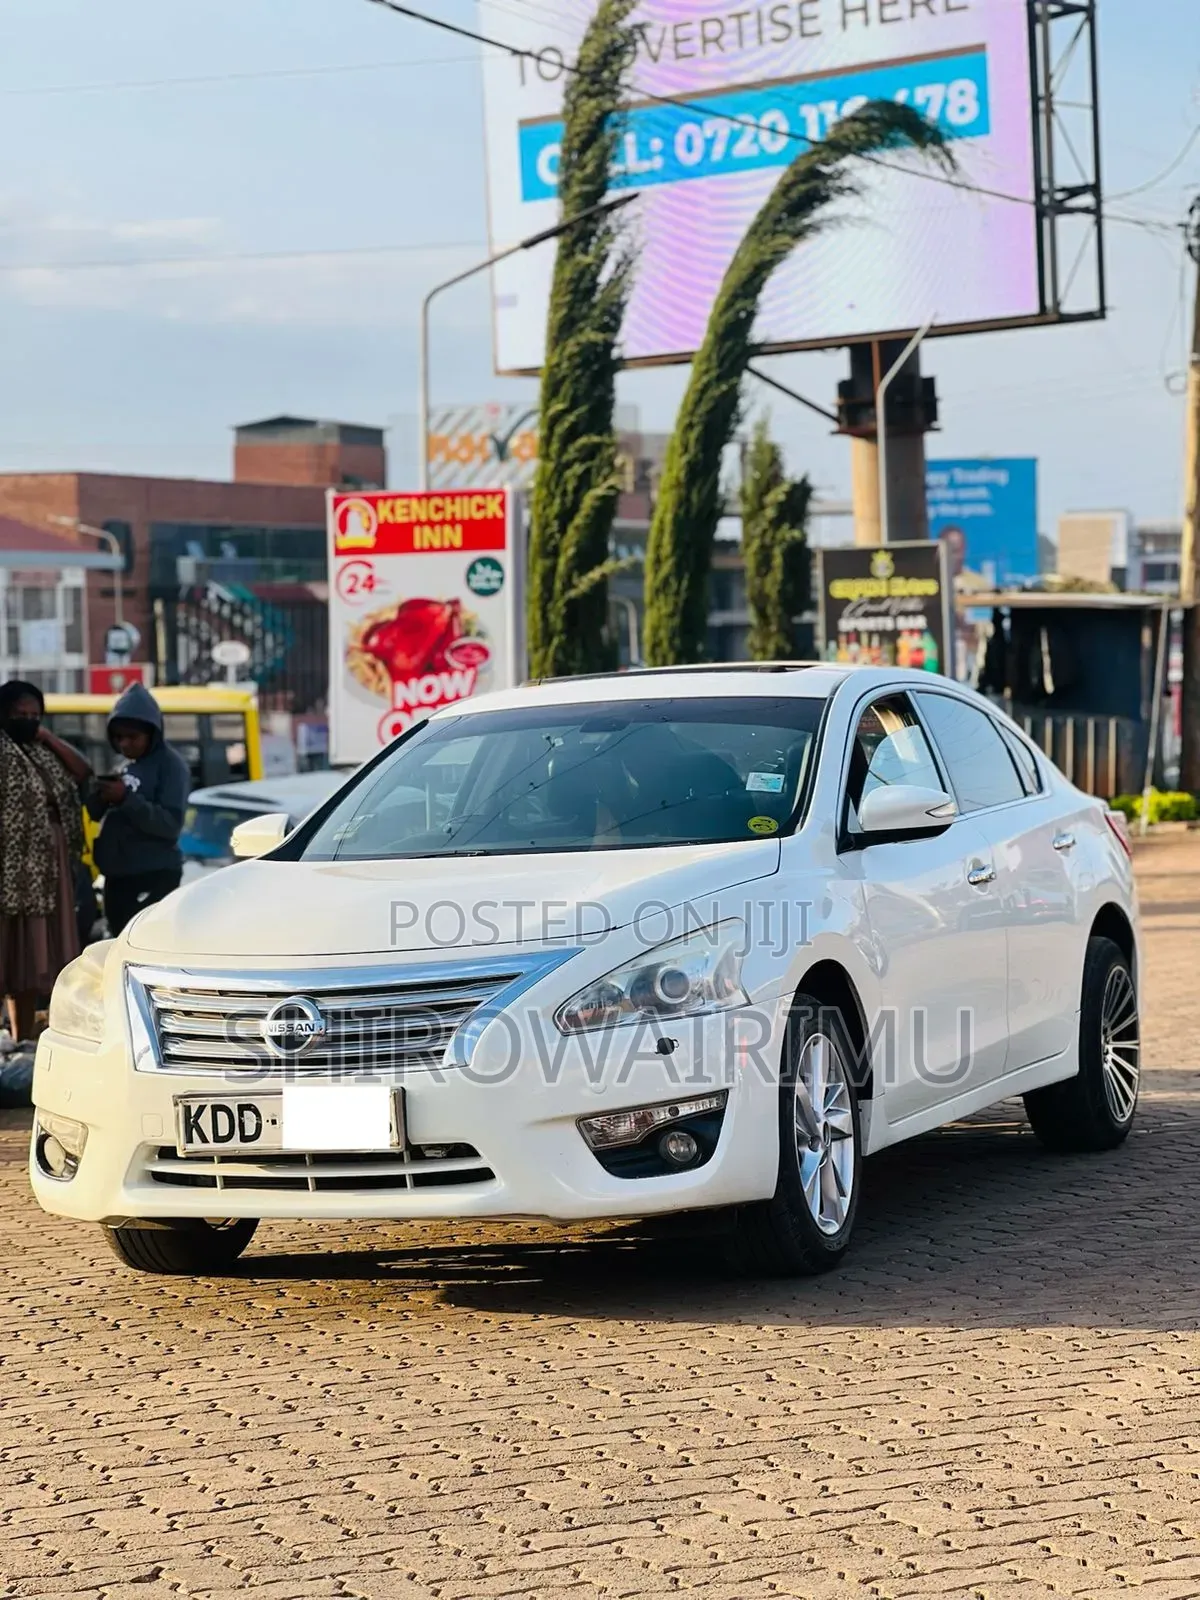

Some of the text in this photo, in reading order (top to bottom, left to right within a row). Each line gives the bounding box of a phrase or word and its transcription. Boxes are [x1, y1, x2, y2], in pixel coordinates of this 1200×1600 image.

[512, 46, 563, 86] TO
[620, 2, 822, 70] VERTISE
[536, 131, 664, 186] CL:
[674, 109, 789, 167] 0720
[893, 78, 980, 128] 78
[377, 494, 504, 524] KENCHICK
[413, 524, 463, 549] INN
[394, 667, 475, 709] NOW
[268, 1023, 315, 1033] NISSAN
[185, 1103, 263, 1144] KDD
